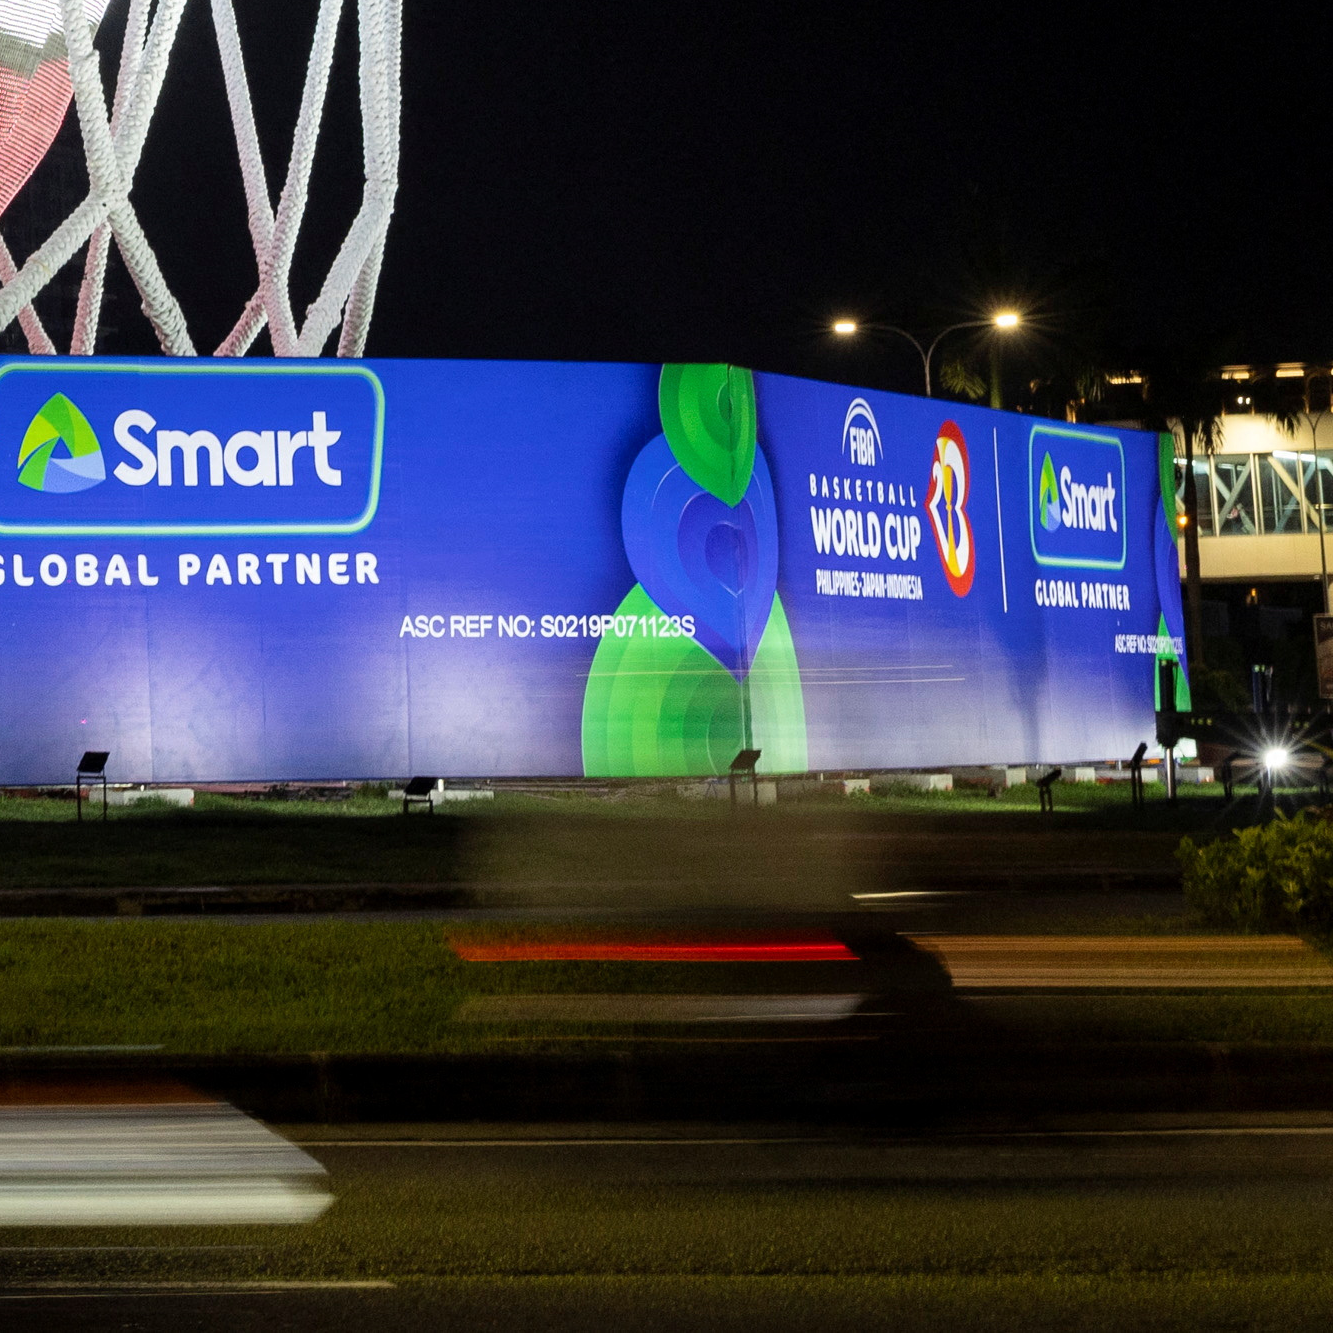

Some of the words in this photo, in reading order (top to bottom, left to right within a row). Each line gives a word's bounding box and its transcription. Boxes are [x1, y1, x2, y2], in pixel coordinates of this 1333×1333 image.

[113, 409, 342, 487] Smart
[849, 426, 876, 467] FIBA
[809, 473, 917, 508] BASKETBALL
[1059, 465, 1118, 533] Smart
[810, 505, 882, 559] WORLD
[884, 512, 922, 562] CUP
[178, 552, 380, 586] PARTNER
[1034, 578, 1080, 609] GLOBAL
[1080, 581, 1131, 611] PARTNER
[398, 614, 446, 638] ASC
[449, 614, 493, 638] REF
[497, 614, 536, 638] NO:
[539, 614, 696, 638] S0219P071123S
